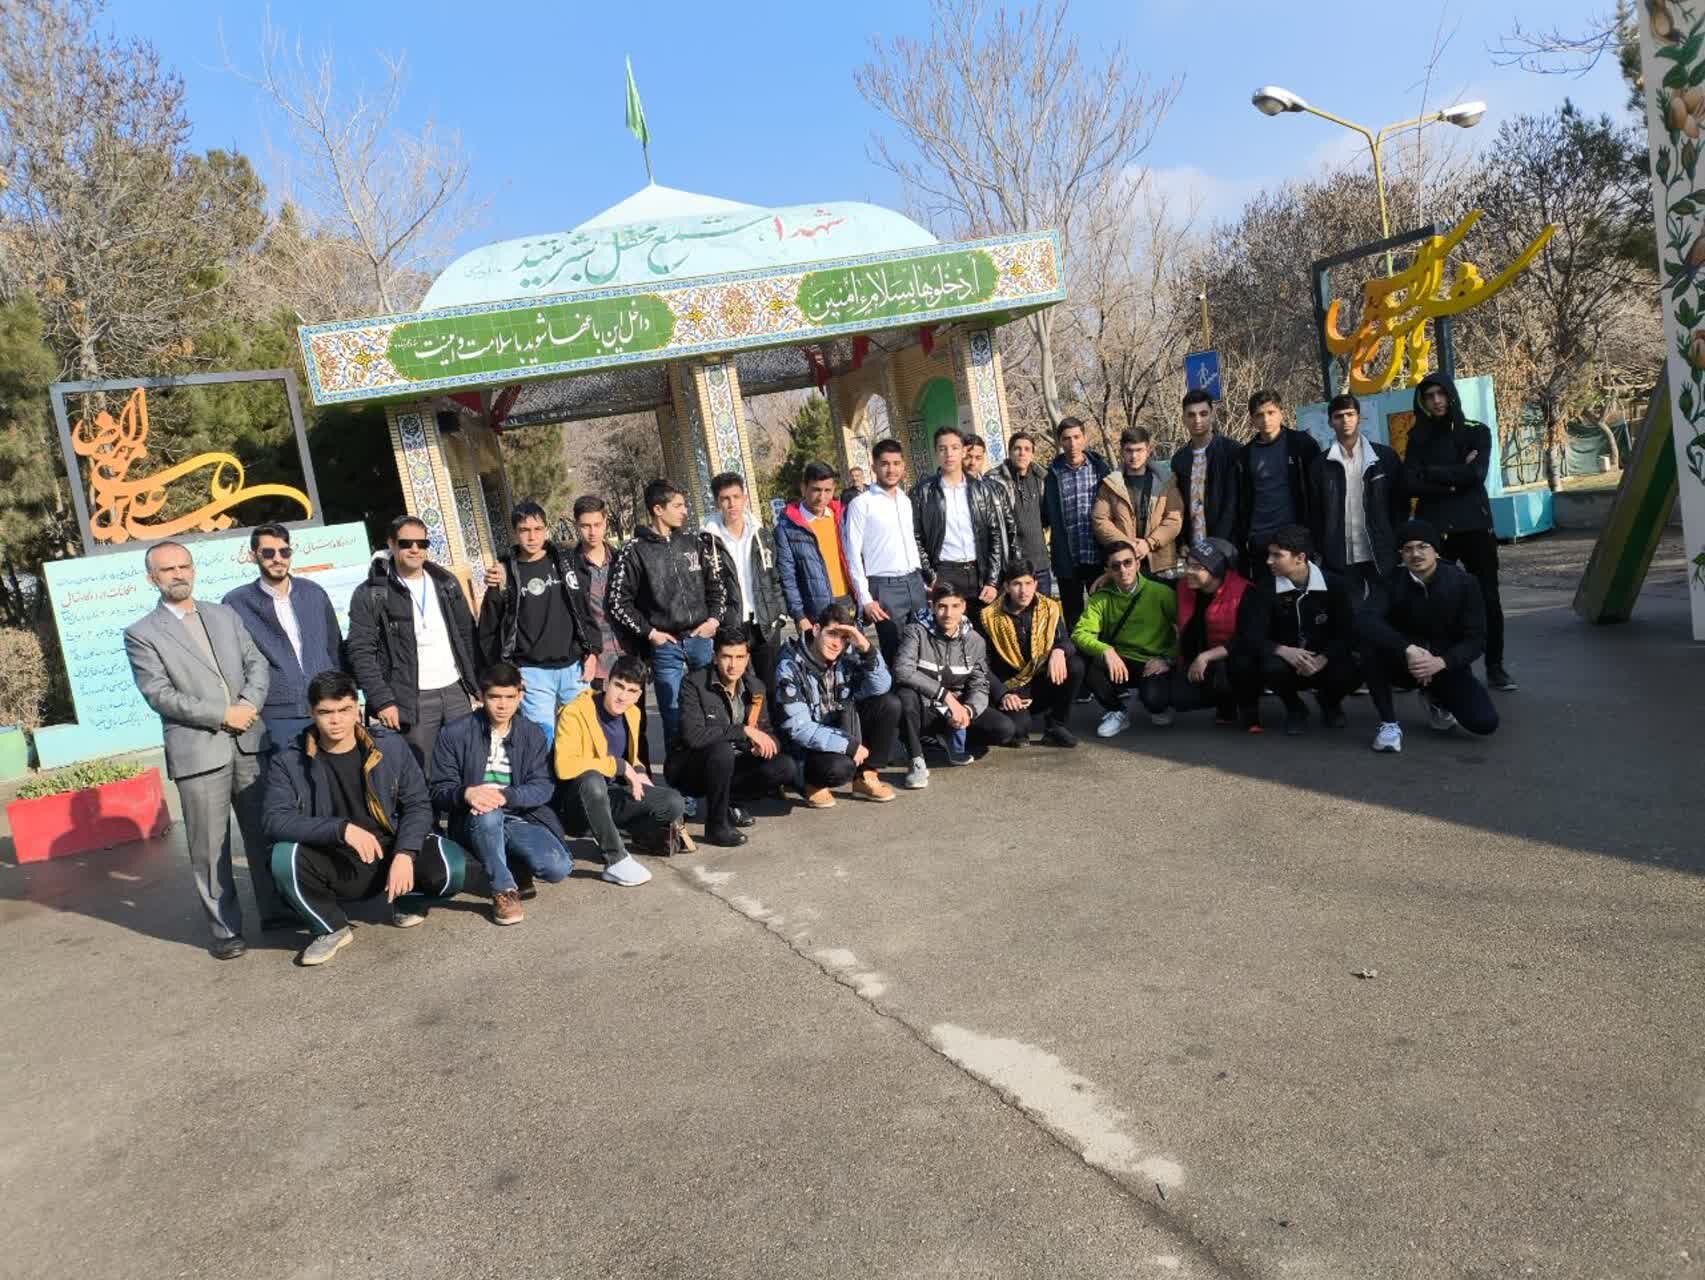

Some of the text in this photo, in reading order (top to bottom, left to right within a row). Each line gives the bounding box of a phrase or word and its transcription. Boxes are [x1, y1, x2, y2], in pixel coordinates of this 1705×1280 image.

[601, 312, 623, 353] این
[619, 299, 650, 343] داخل
[457, 332, 512, 360] سلامت
